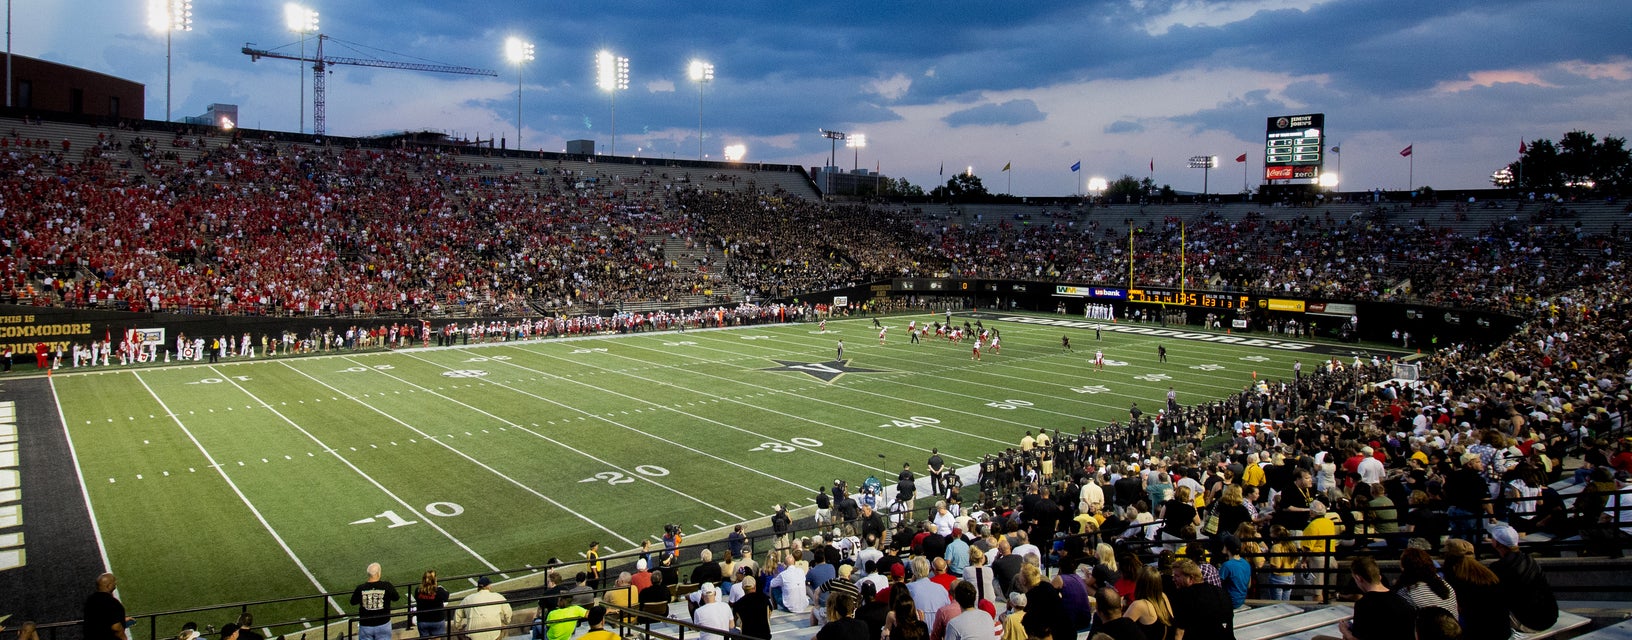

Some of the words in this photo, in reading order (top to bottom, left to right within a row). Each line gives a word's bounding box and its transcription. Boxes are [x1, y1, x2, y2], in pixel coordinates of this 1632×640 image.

[0, 315, 21, 323] THIS
[25, 315, 35, 323] IS
[0, 324, 91, 337] COMMODORE
[0, 341, 70, 355] COUNRY
[891, 416, 940, 428] 40
[760, 437, 823, 453] 30
[595, 465, 670, 485] 20
[375, 502, 464, 528] 10
